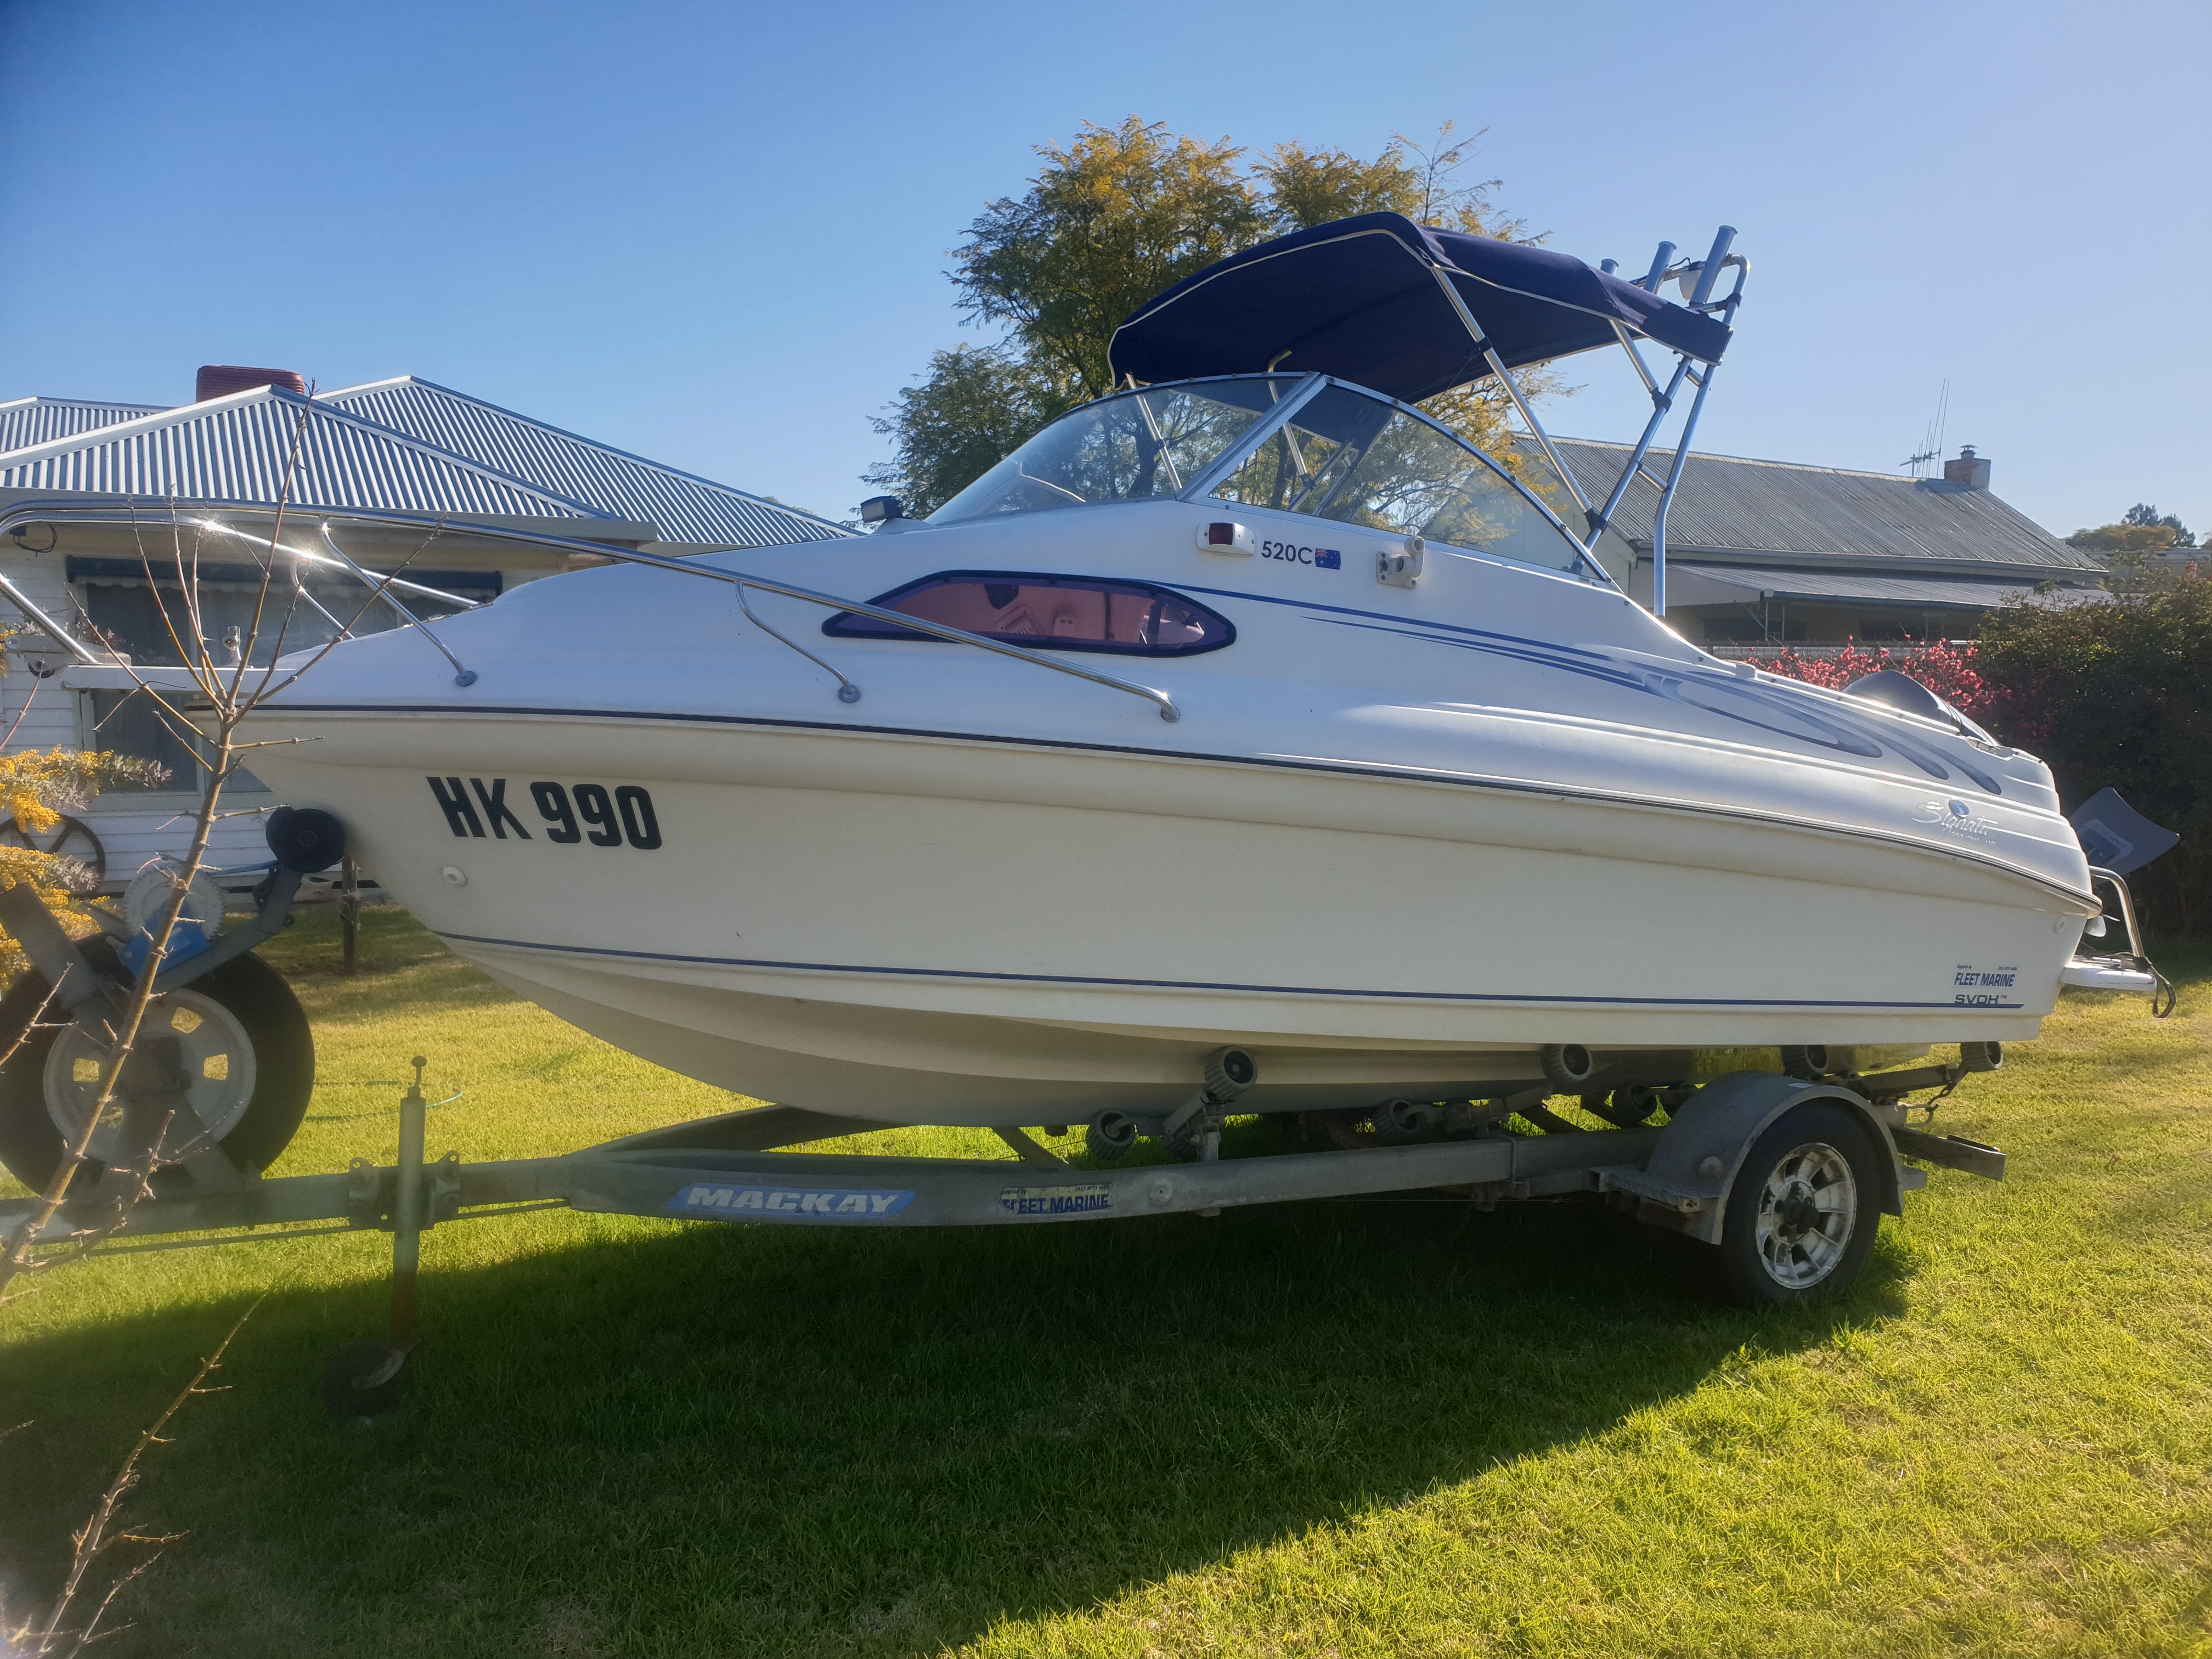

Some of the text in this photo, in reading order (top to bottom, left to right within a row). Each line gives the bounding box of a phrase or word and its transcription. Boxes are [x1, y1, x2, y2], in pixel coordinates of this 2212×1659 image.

[1261, 540, 1312, 565] 520C
[426, 776, 662, 850] HK 990
[1954, 972, 2016, 987] FLEET MARINE
[687, 1187, 899, 1212] MACKAY
[1049, 1194, 1109, 1214] MARINE
